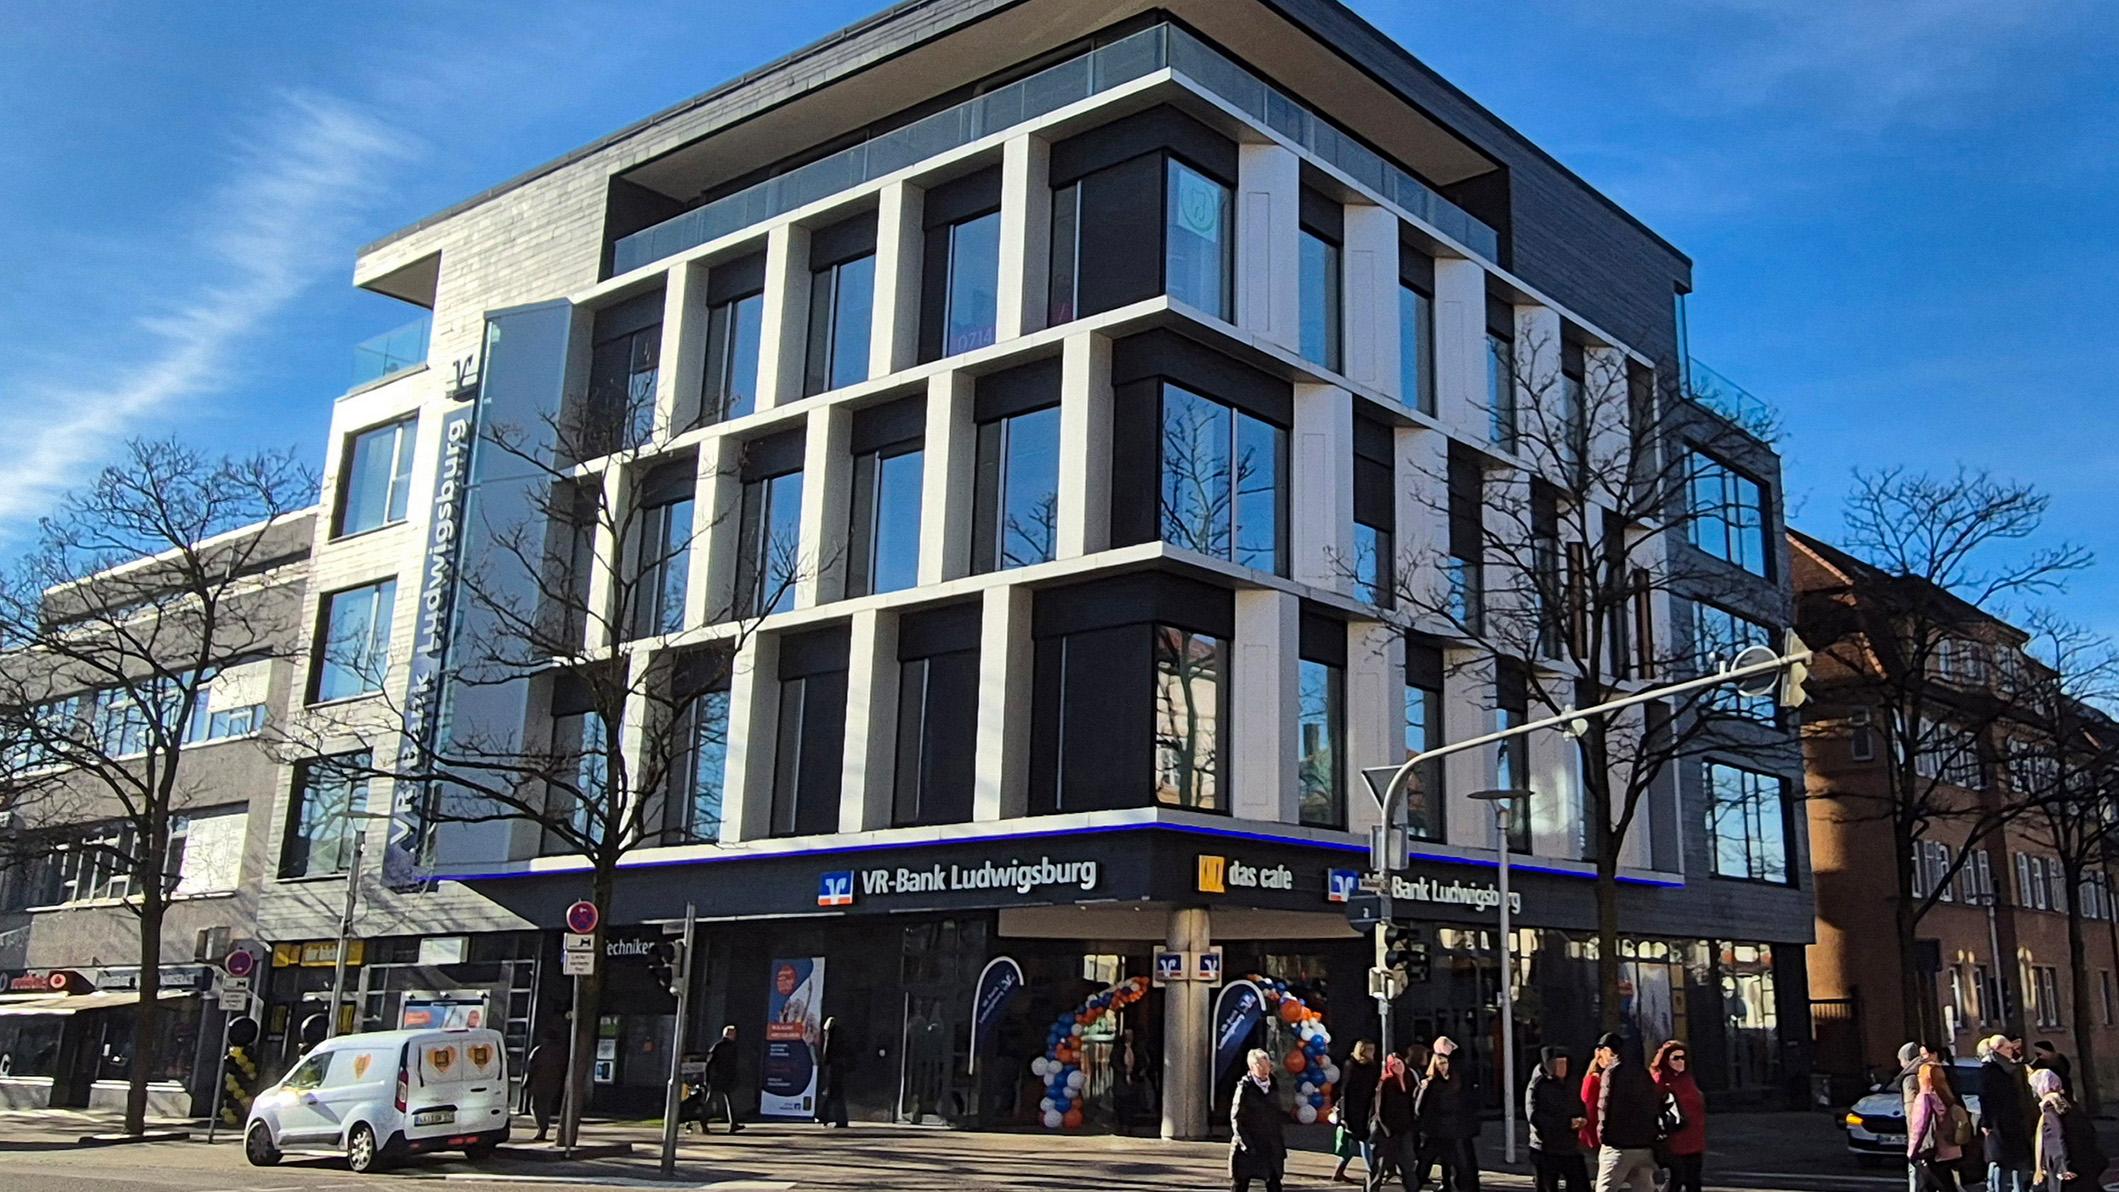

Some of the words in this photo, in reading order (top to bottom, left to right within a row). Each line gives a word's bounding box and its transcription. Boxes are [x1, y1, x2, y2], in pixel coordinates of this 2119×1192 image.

[417, 418, 467, 653] Ludwigsburg
[861, 864, 946, 894] VR-Bank
[951, 856, 1097, 894] Ludwigsburg
[1228, 860, 1257, 887] das
[1432, 879, 1521, 914] Ludwigsbg
[606, 938, 655, 956] echniker
